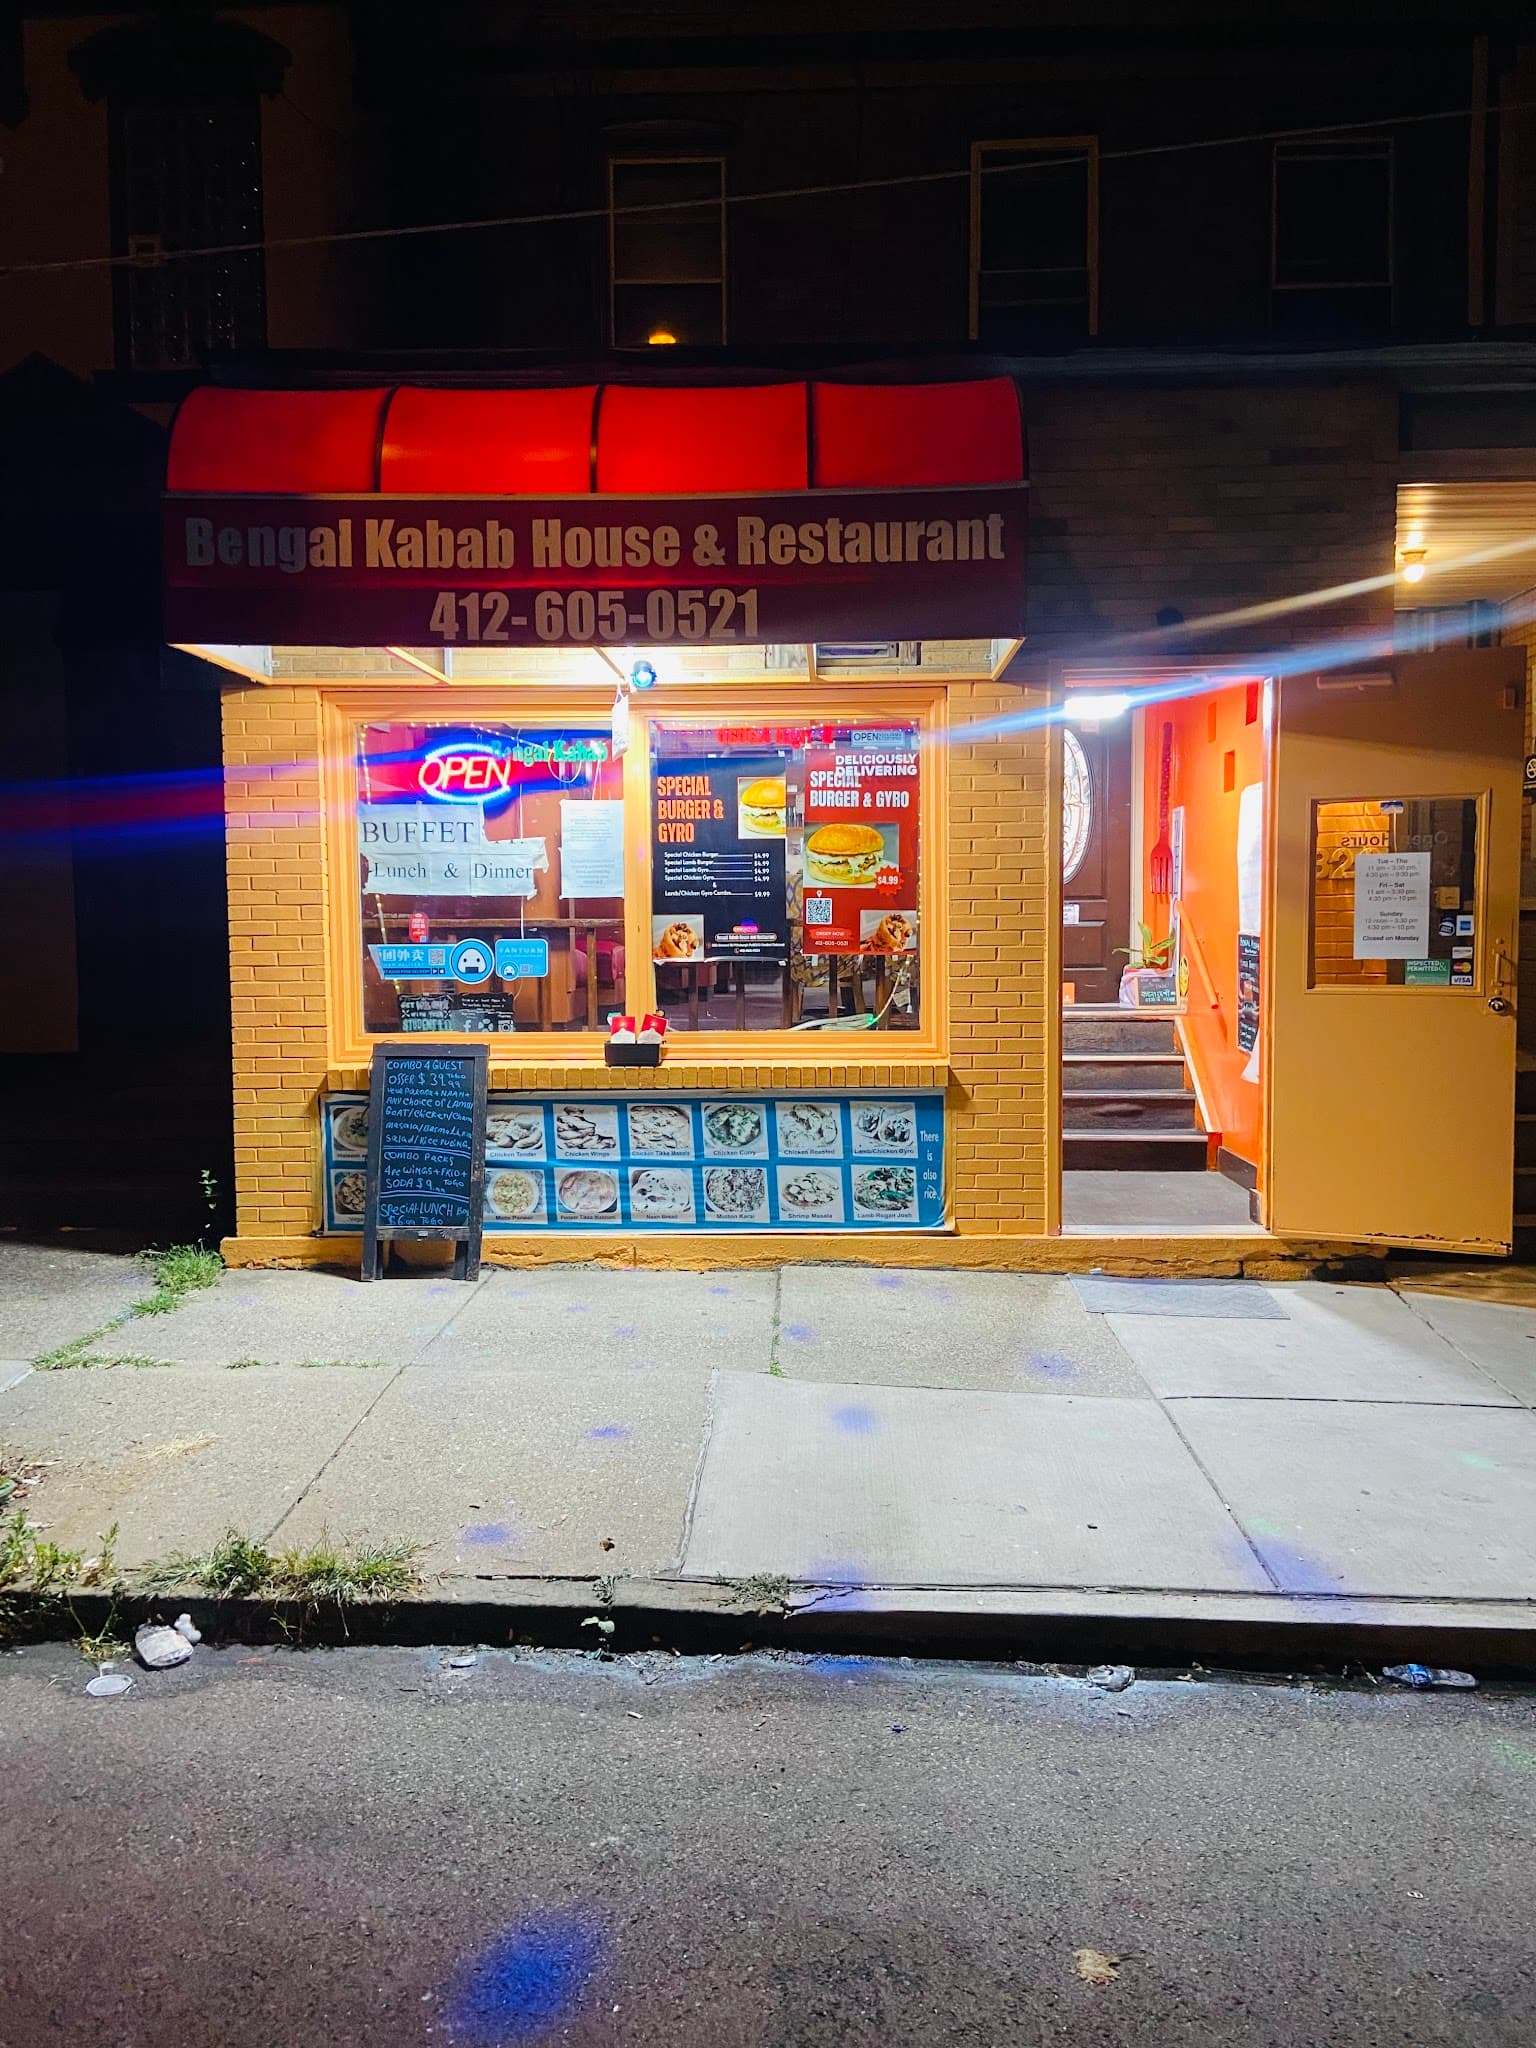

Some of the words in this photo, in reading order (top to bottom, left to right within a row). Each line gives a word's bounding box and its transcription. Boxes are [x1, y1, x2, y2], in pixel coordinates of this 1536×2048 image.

[184, 516, 353, 573] Bengal
[366, 518, 516, 570] Kabab
[532, 519, 680, 569] House
[693, 523, 725, 567] &
[737, 513, 1006, 566] Restaurant
[429, 588, 760, 642] 412-605-0521
[853, 732, 879, 741] OPEN
[835, 753, 917, 766] DELICIOUSLY
[418, 757, 511, 791] OPEN
[835, 764, 918, 777] DELIVERING
[657, 776, 711, 796] SPECIAL
[810, 771, 862, 788] SPECIAL
[810, 791, 858, 808] BURGER
[862, 792, 872, 808] &
[876, 791, 909, 808] GYRO
[657, 800, 710, 820] BURGER
[713, 800, 724, 819] &
[362, 821, 475, 844] BUFFET
[658, 823, 695, 843] GYRO
[374, 863, 427, 879] Lunch
[444, 863, 459, 879] &
[473, 863, 533, 880] Dinner
[877, 875, 899, 886] $4.99
[380, 949, 425, 962] 团外卖
[387, 1061, 422, 1070] COMBO
[424, 1061, 430, 1070] 4
[432, 1060, 464, 1070] GUEST
[919, 1130, 939, 1142] There
[926, 1150, 933, 1161] is
[923, 1169, 937, 1180] also
[386, 1178, 413, 1188] SODA
[924, 1187, 937, 1199] rice
